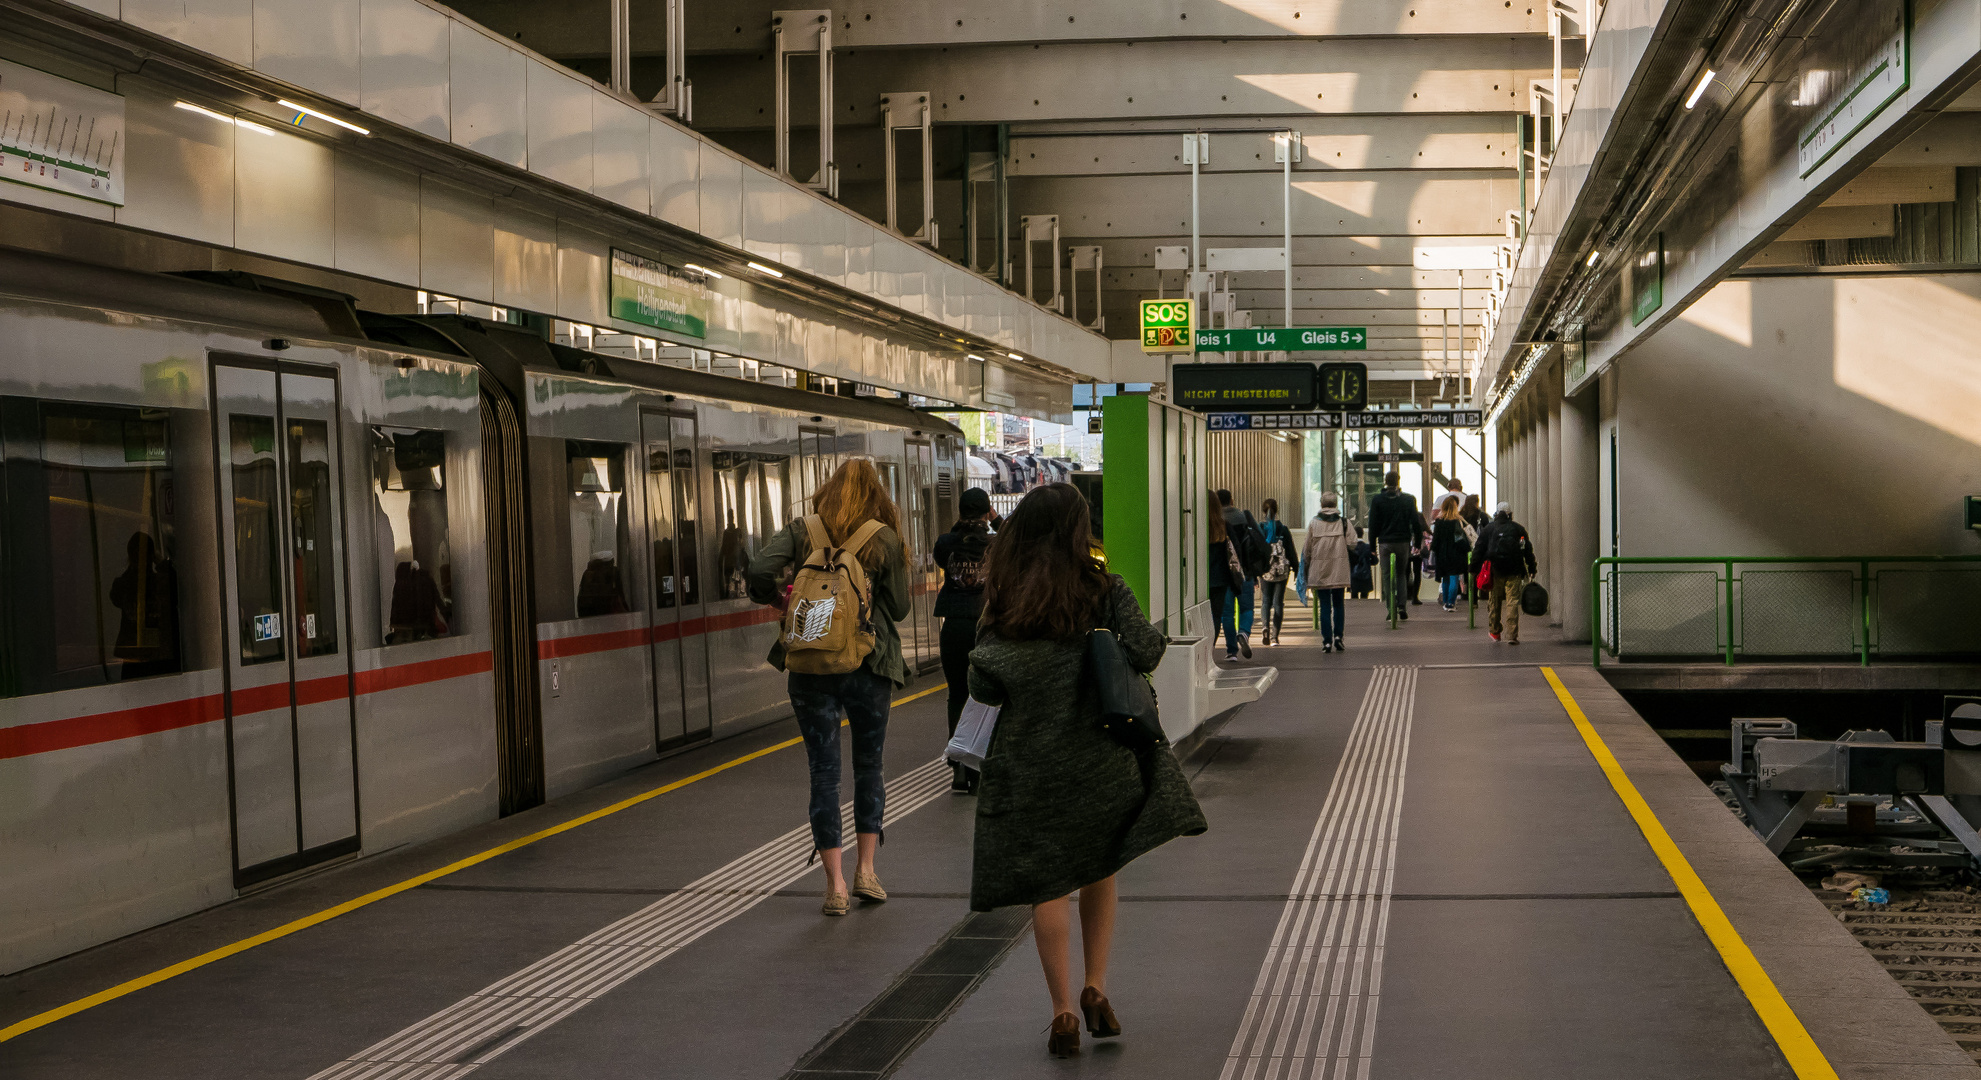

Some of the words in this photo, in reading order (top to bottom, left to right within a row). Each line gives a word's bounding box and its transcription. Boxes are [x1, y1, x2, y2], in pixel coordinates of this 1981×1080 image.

[637, 285, 686, 325] Heiligenstadt
[1145, 304, 1187, 323] SOS
[1196, 333, 1220, 345] leis
[1224, 333, 1231, 345] 1
[1257, 332, 1276, 345] U4
[1301, 331, 1337, 344] Gleis
[1340, 331, 1350, 344] 5
[1184, 390, 1217, 399] NICHT
[1223, 389, 1289, 399] EINSTEIGEN
[1362, 415, 1376, 424] 12.
[1377, 414, 1448, 424] Februar-Platz
[1762, 768, 1777, 777] HS
